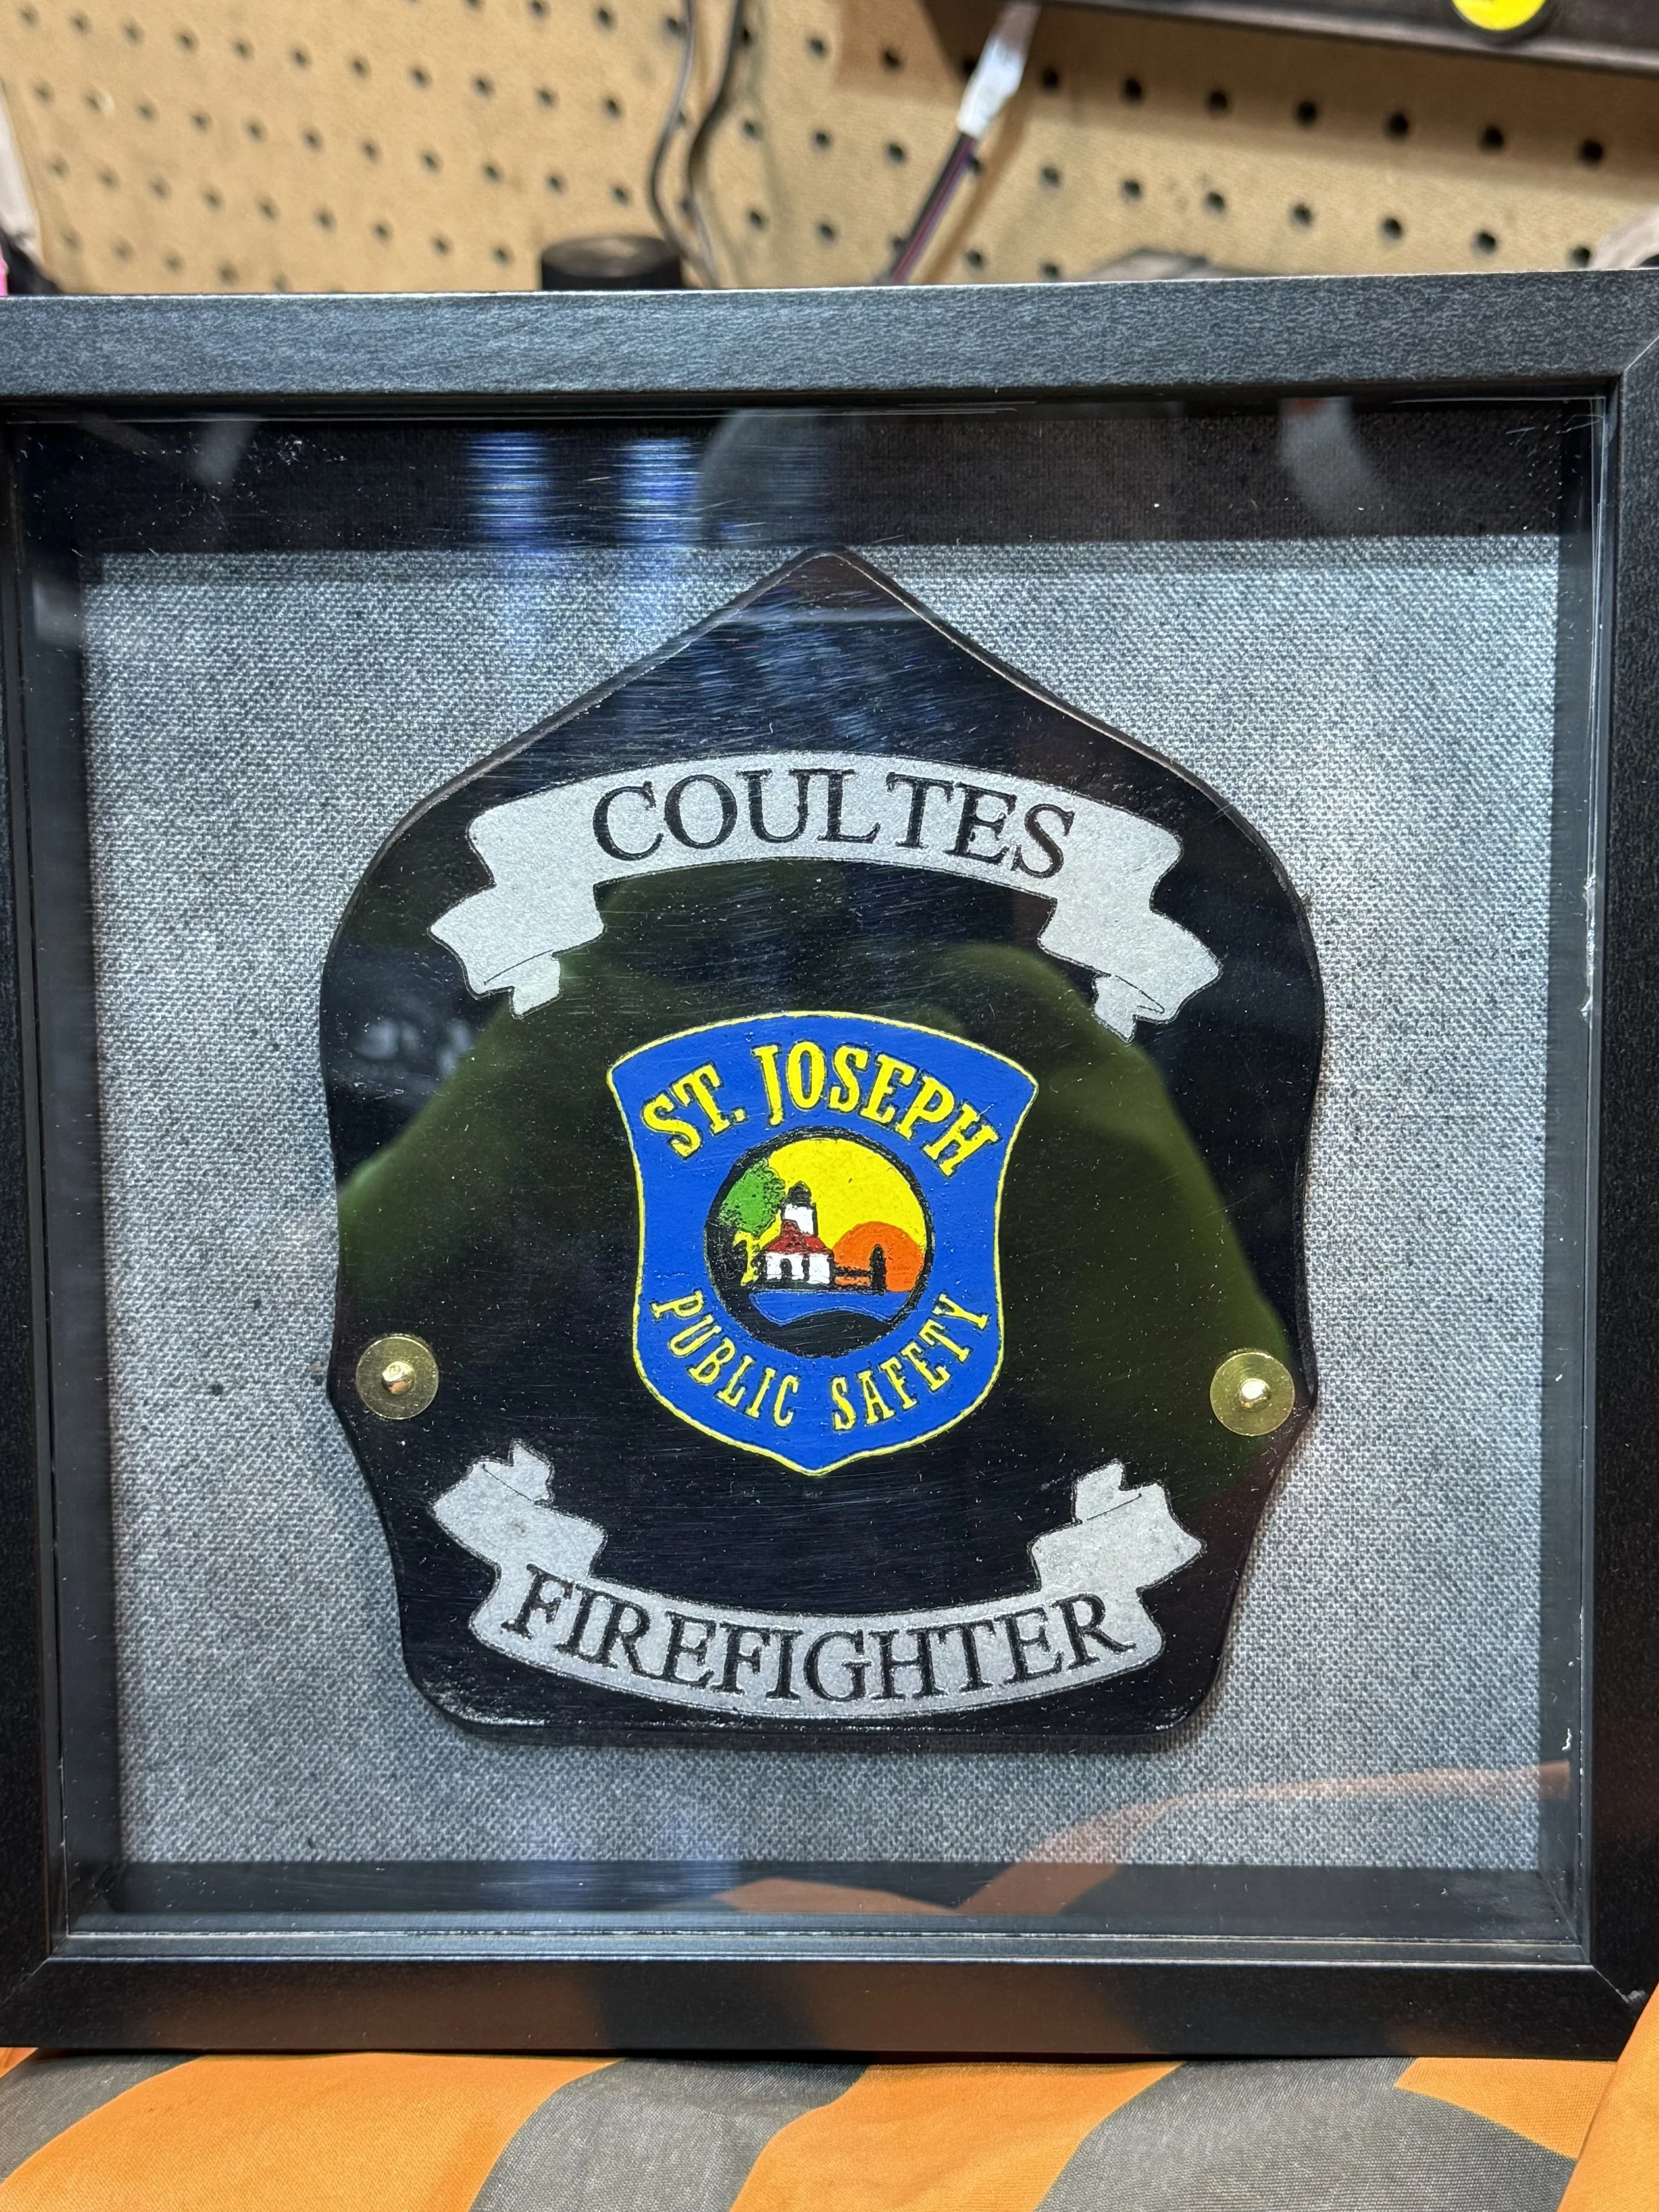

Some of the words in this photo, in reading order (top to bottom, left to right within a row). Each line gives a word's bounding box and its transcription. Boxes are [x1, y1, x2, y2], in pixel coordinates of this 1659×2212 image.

[593, 768, 1076, 879] COULTES
[641, 1062, 747, 1158] ST.
[753, 1039, 1001, 1177] JOSEPH
[650, 1289, 799, 1427] PUBLIC
[829, 1293, 989, 1432] SAFETY
[501, 1564, 1137, 1702] FIREFIGHTER
